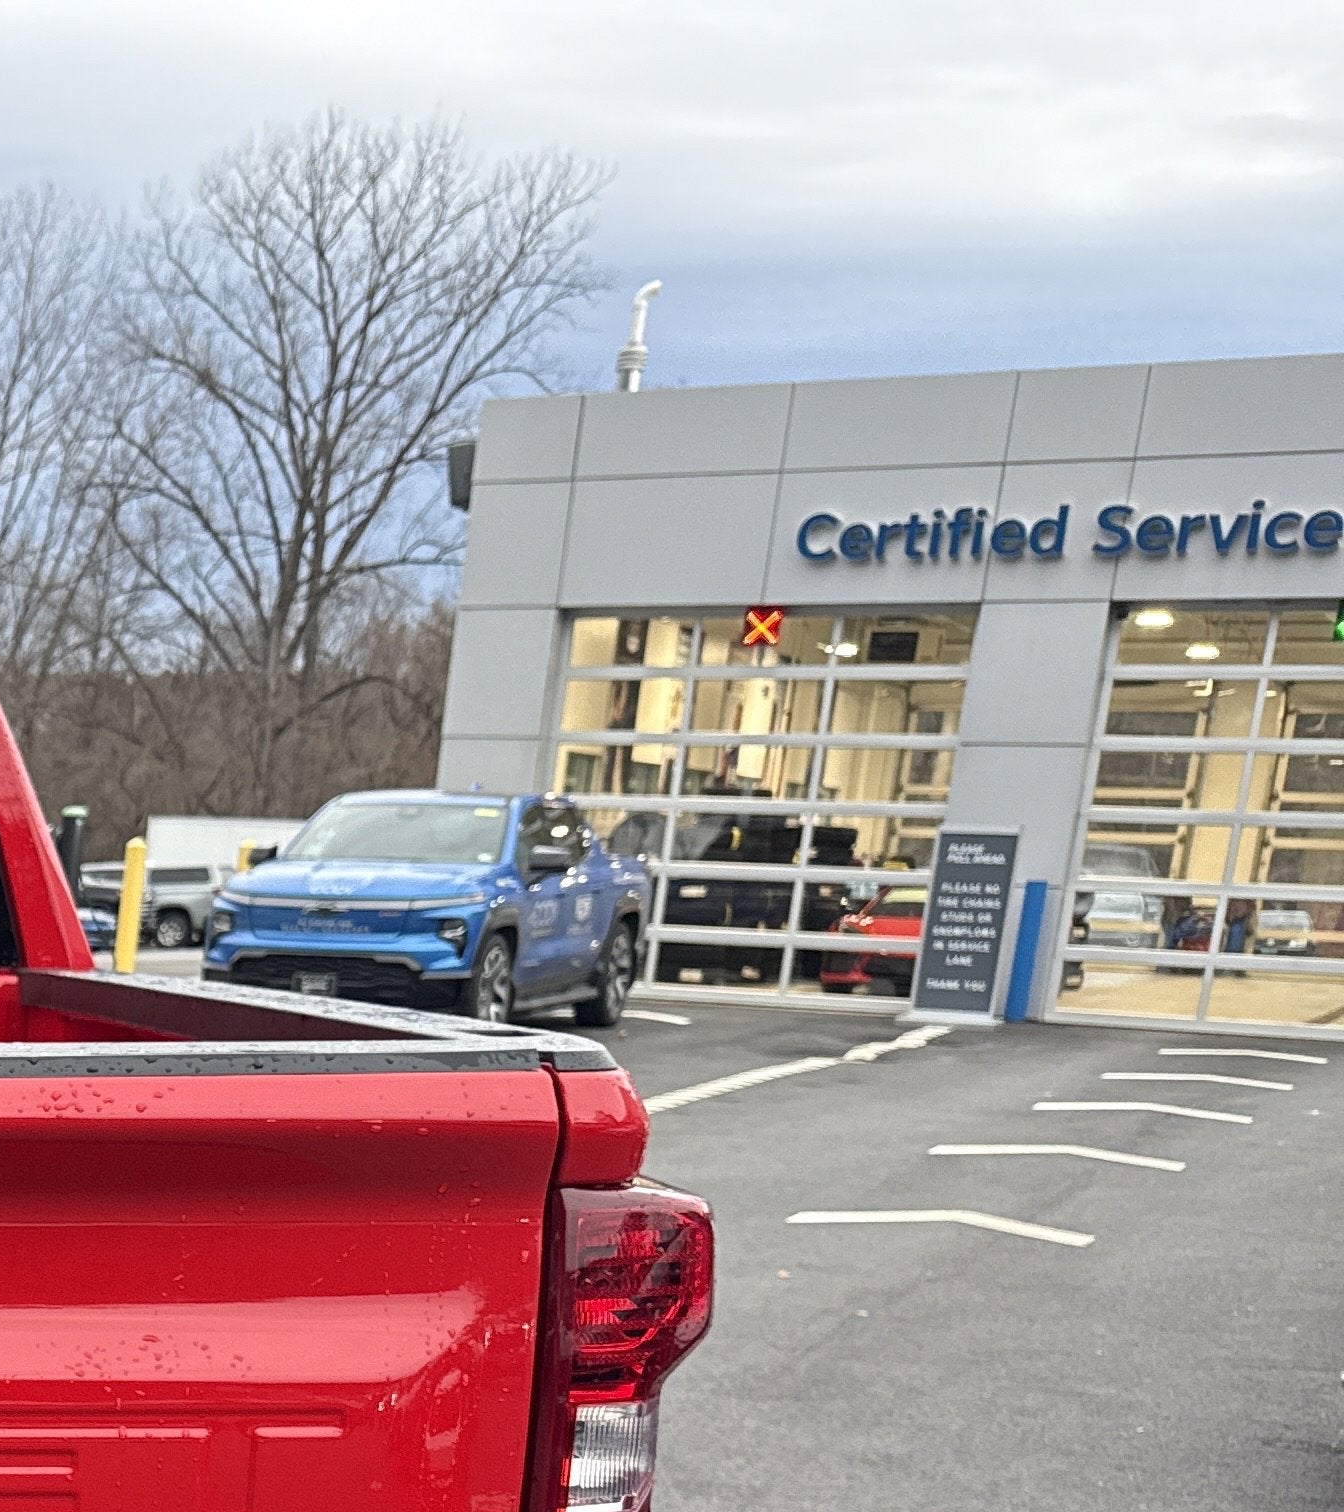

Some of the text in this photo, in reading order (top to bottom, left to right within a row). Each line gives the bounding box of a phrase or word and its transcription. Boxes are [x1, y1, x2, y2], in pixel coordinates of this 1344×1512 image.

[797, 501, 1344, 561] Certified Service
[941, 882, 1000, 895] PLEASE NO
[961, 896, 1002, 910] CHAINS
[947, 940, 991, 953] SERVICE
[945, 954, 973, 966] LANE
[926, 978, 986, 992] THANK YOU
